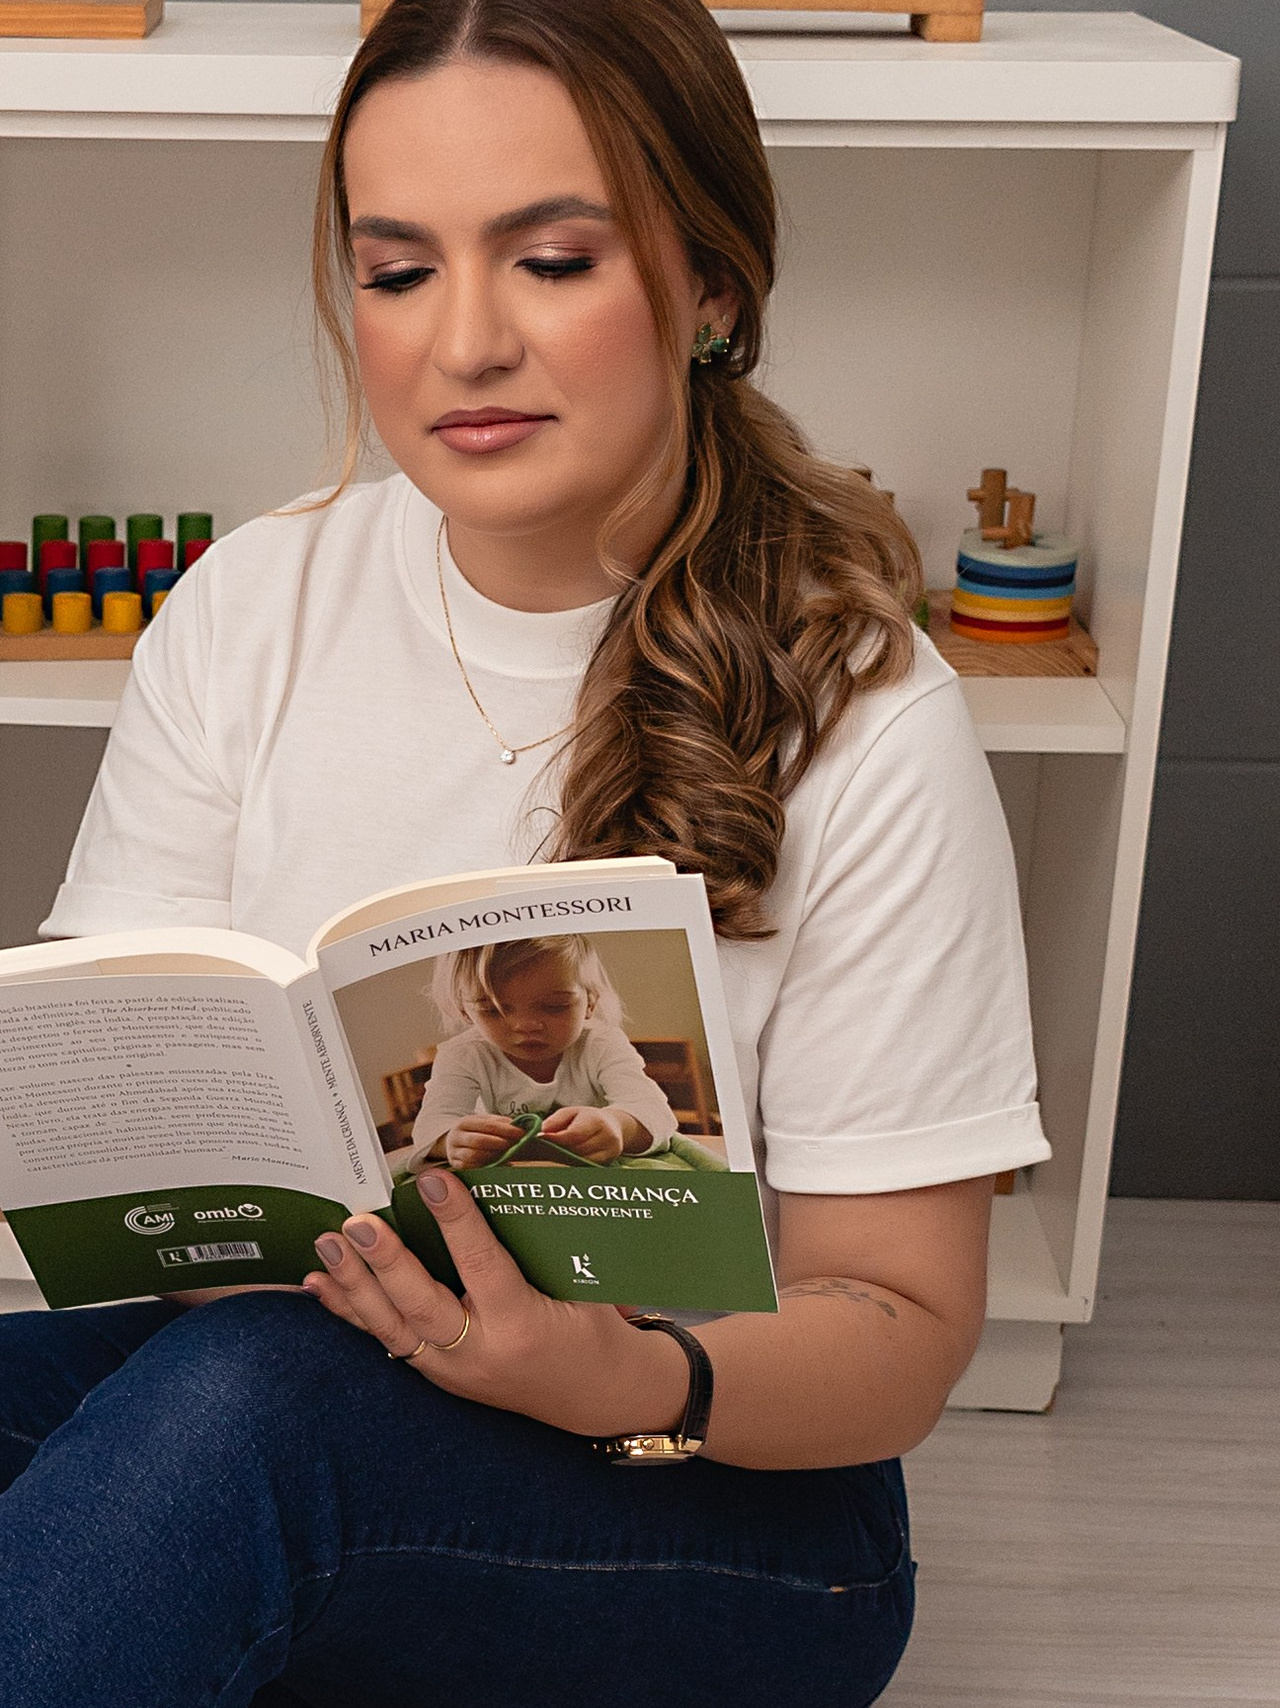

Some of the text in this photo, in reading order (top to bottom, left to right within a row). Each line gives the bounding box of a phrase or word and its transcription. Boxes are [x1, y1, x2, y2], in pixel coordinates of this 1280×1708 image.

[369, 896, 632, 957] MARIA MONTESSORI
[25, 1001, 73, 1011] brasileira
[125, 996, 153, 1004] partir
[120, 1004, 168, 1012] Absorbent
[202, 1005, 252, 1014] publicado
[8, 1031, 60, 1041] despertou
[113, 1032, 175, 1043] pensamento
[194, 1033, 249, 1041] enriqueceu
[303, 1000, 338, 1090] MENTE ABSORVENTE
[97, 1053, 124, 1061] texto
[20, 1081, 56, 1089] volume
[60, 1077, 94, 1085] nasceu
[119, 1069, 165, 1080] palestras
[25, 1086, 82, 1099] Montessori
[84, 1081, 123, 1091] durante
[136, 1077, 178, 1087] primeiro
[36, 1095, 97, 1106] desenvolveu
[56, 1105, 86, 1113] durou
[159, 1094, 201, 1103] Segunda
[6, 1120, 34, 1128] Neste
[82, 1110, 107, 1118] trata
[130, 1104, 171, 1113] energias
[334, 1100, 352, 1138] CRIANÇA
[21, 1128, 57, 1136] tornam
[63, 1123, 90, 1131] capaz
[15, 1138, 47, 1147] ajudas
[50, 1128, 113, 1142] educacionais
[23, 1153, 67, 1163] construir
[149, 1140, 182, 1148] espaço
[37, 1144, 65, 1152] conta
[114, 1149, 182, 1163] personalidade
[261, 1156, 309, 1170] Montessori
[348, 1150, 365, 1180] MENTE
[548, 1184, 583, 1199] DA
[587, 1185, 699, 1207] CRIANÇA
[143, 1212, 175, 1225] AMI
[489, 1204, 653, 1219] MENTE ABSORVENTE
